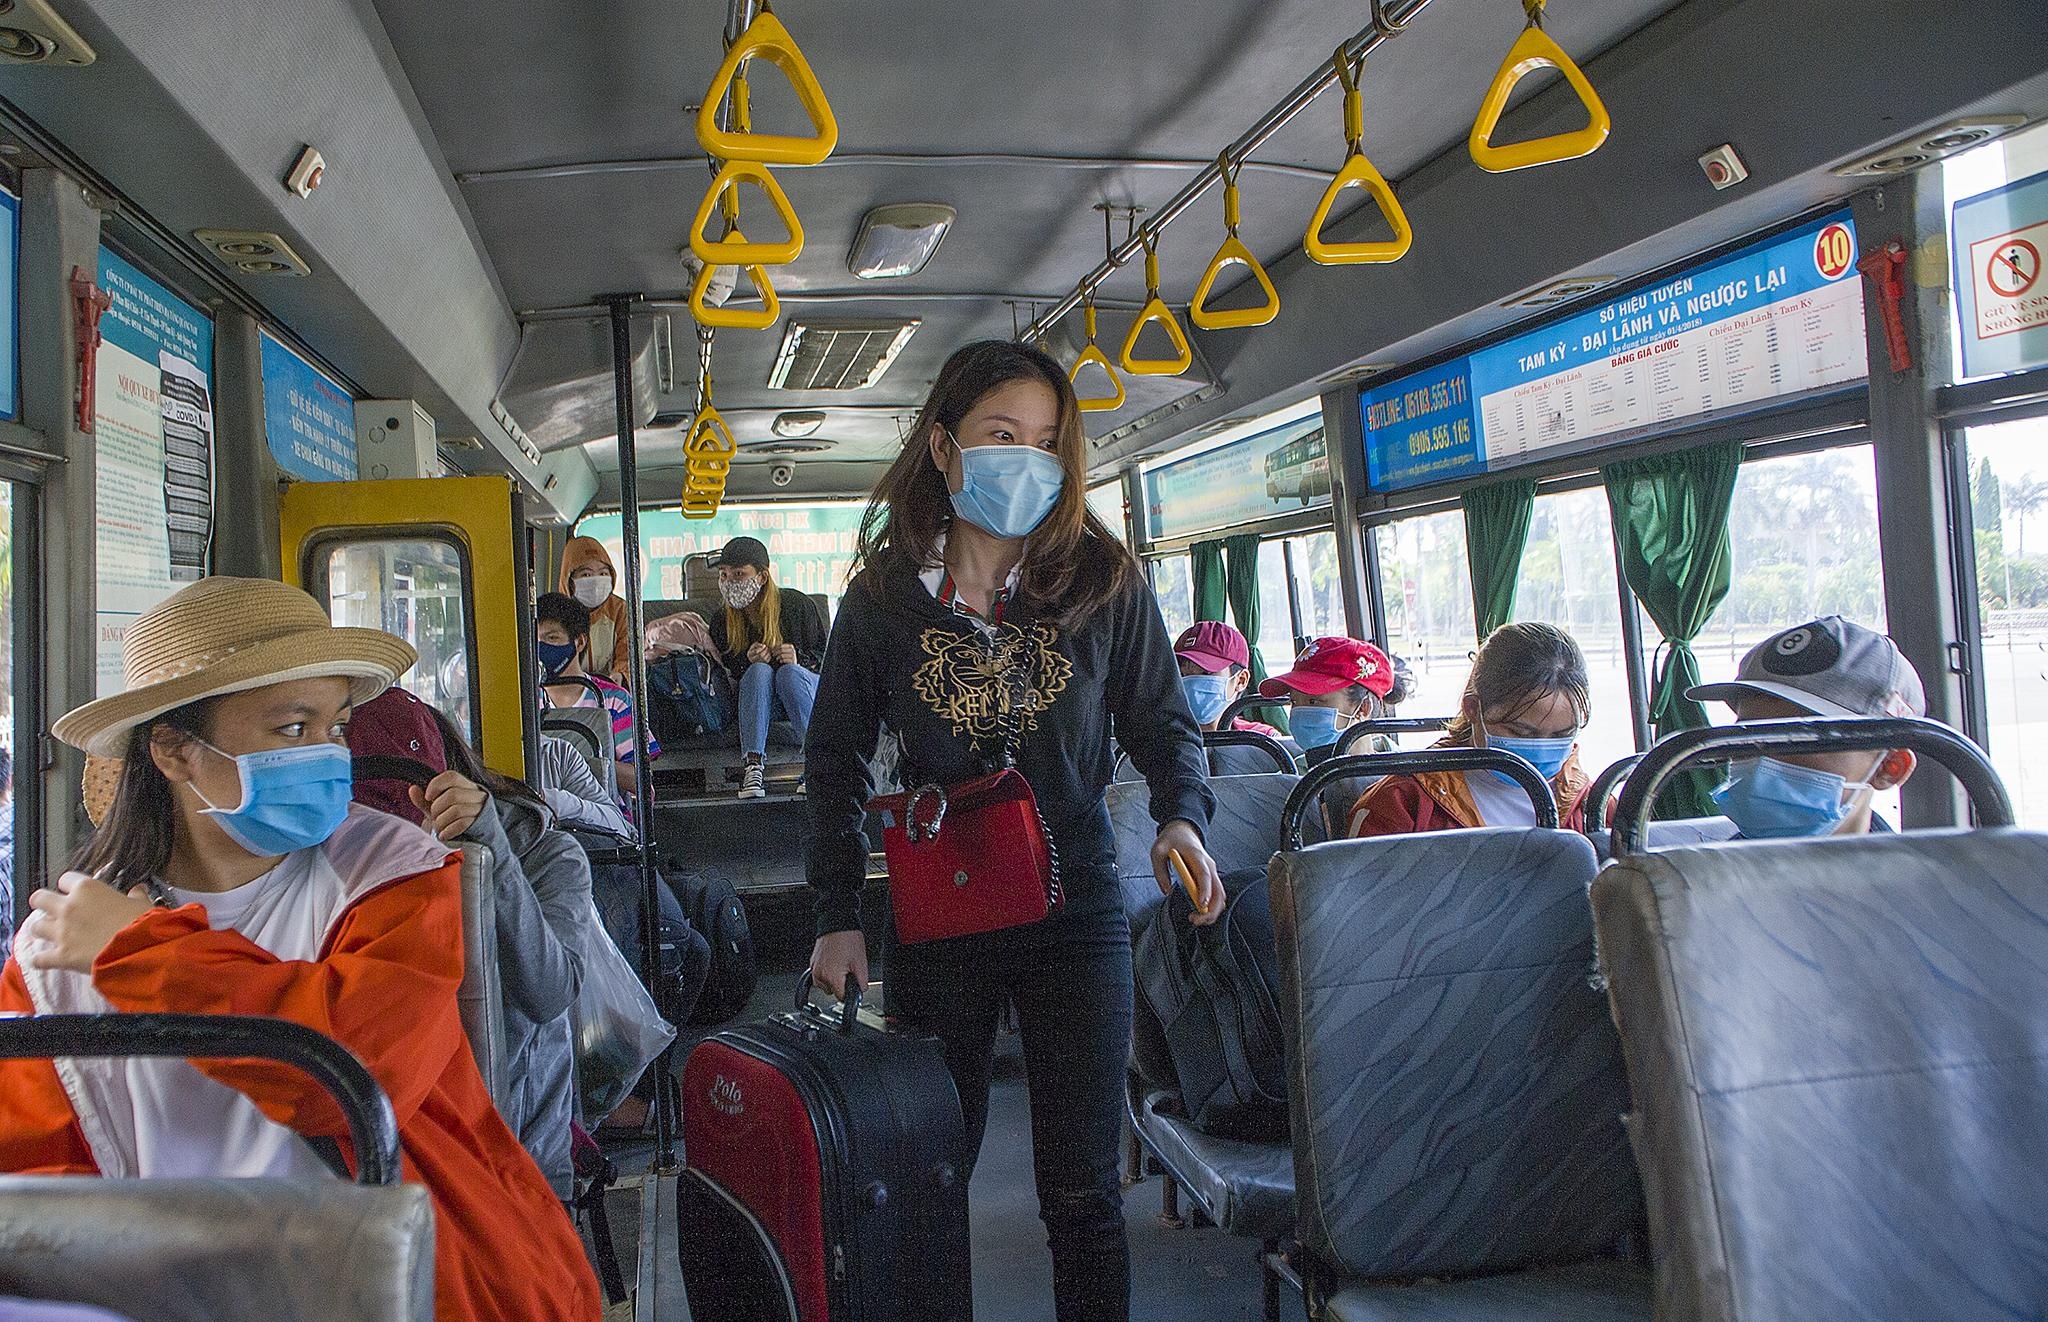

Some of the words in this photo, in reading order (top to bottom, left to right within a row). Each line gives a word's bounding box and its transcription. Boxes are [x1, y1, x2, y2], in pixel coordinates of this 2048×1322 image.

[1820, 230, 1849, 273] 10
[1619, 296, 1647, 314] HIỆU
[1779, 303, 1799, 316] Tam
[1518, 354, 1546, 373] TAM
[1582, 331, 1607, 352] ĐẠI
[1612, 313, 1653, 342] LÃNH
[1658, 301, 1680, 326] VÀ
[1687, 280, 1748, 316] NGƯỢC
[1755, 266, 1787, 293] LẠI
[1781, 633, 1804, 651] 8
[716, 1074, 742, 1101] Polo
